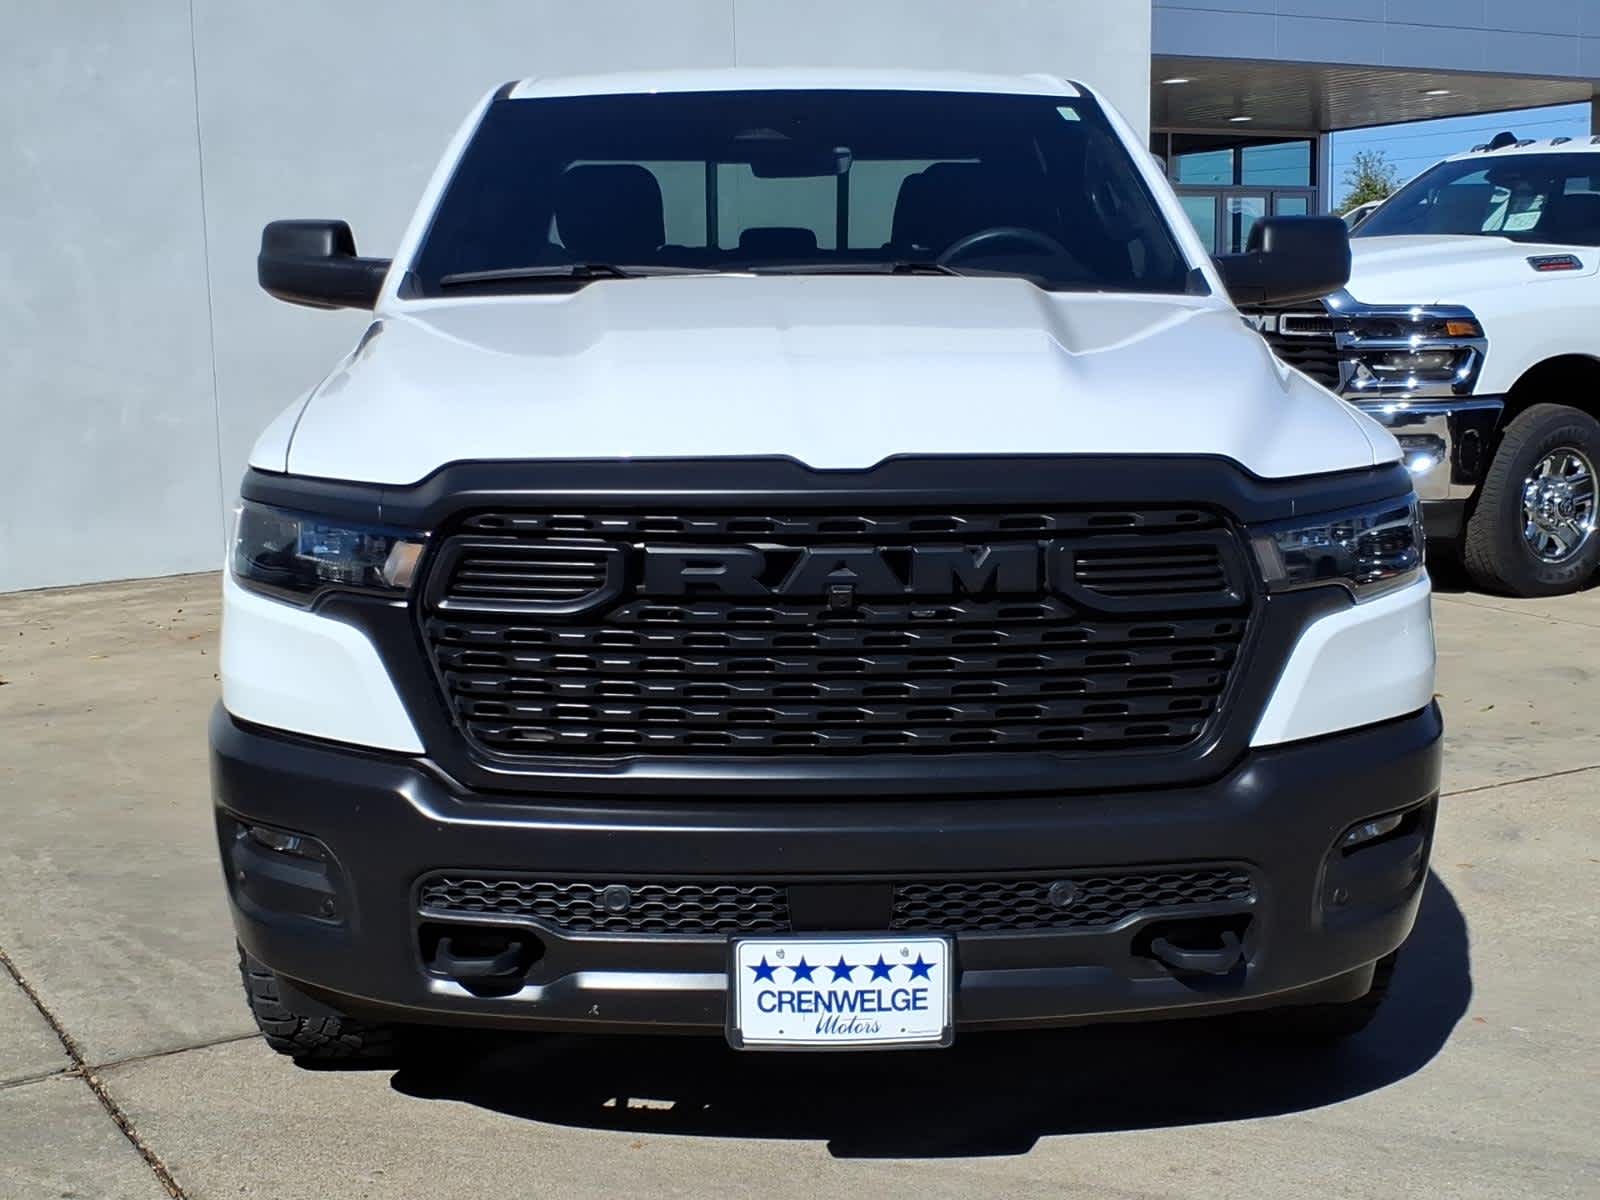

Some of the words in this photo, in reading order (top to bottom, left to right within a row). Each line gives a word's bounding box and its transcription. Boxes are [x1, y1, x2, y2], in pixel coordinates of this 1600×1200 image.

[641, 544, 1039, 595] RAM
[757, 988, 928, 1013] CRENWELGE
[815, 1012, 881, 1034] Motors
